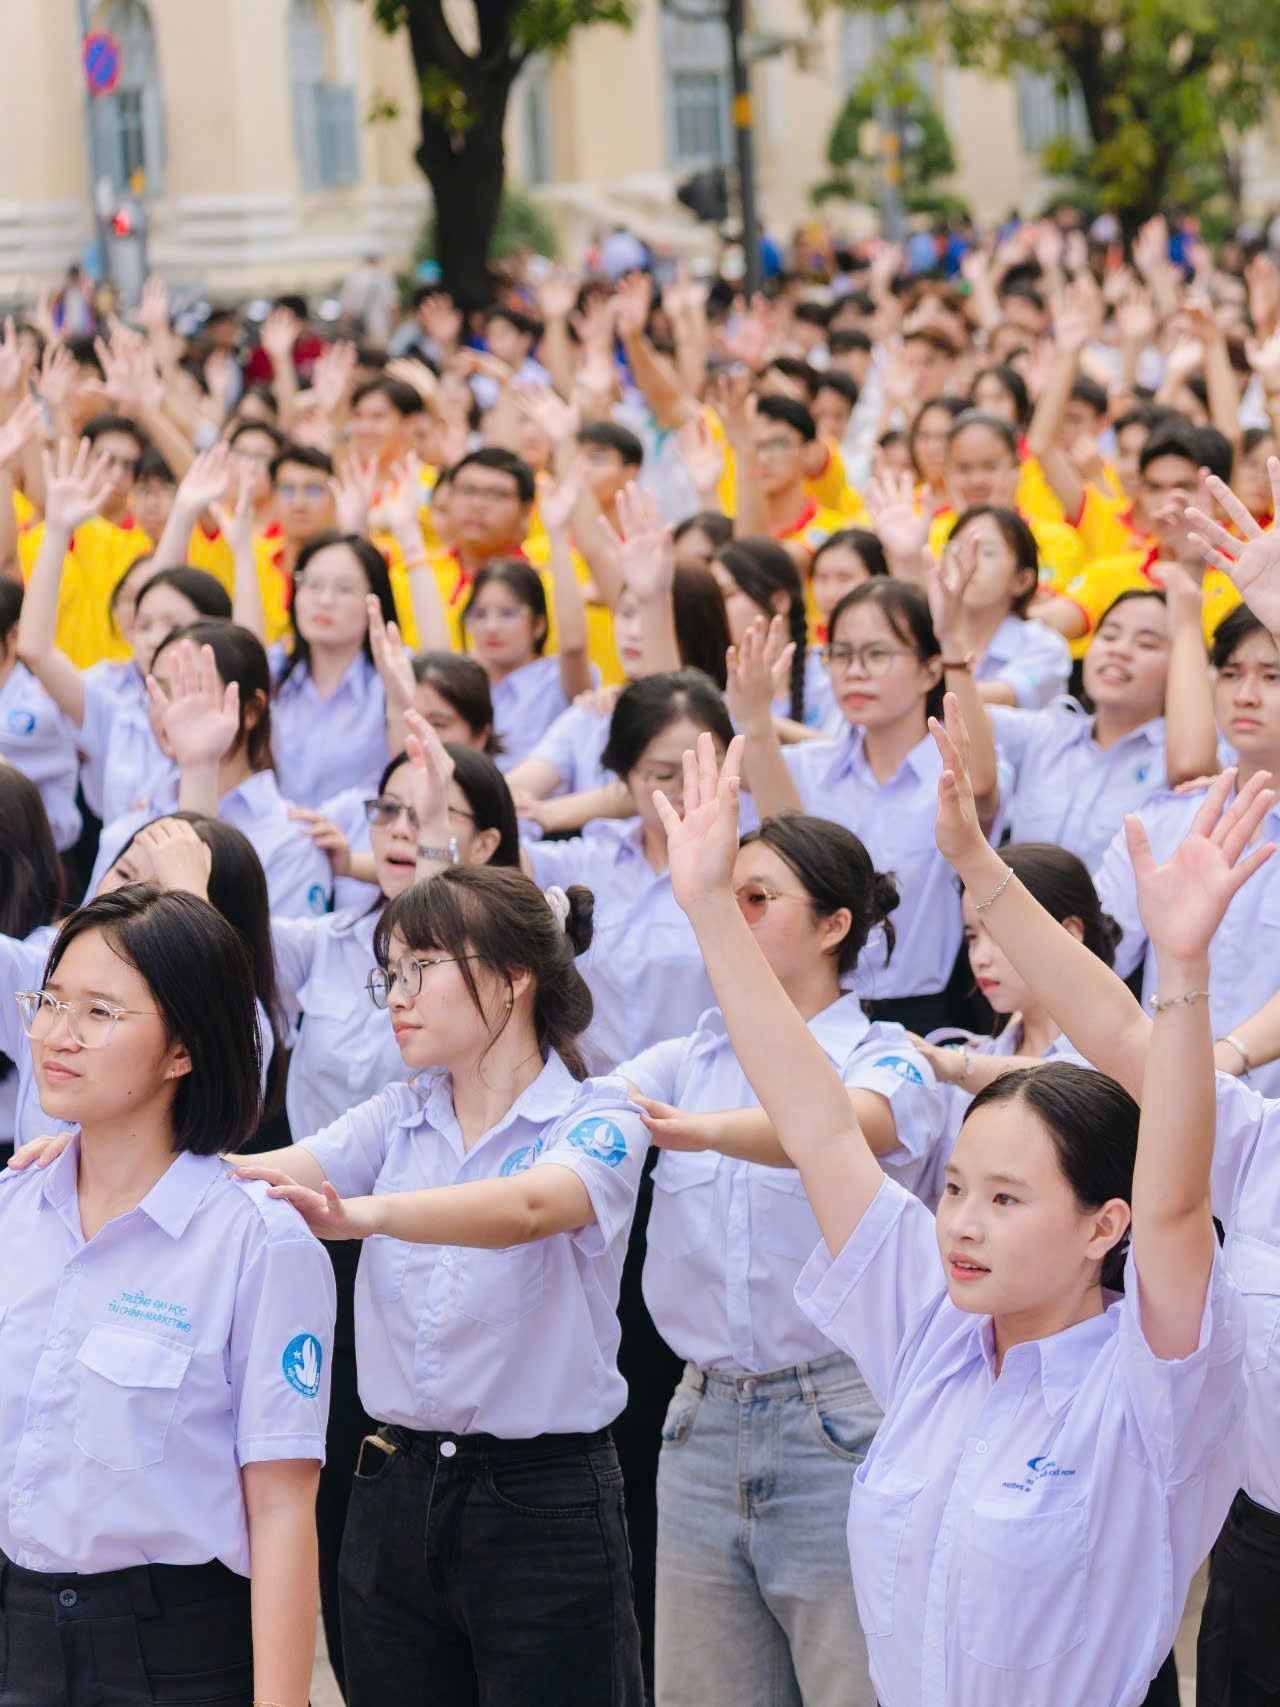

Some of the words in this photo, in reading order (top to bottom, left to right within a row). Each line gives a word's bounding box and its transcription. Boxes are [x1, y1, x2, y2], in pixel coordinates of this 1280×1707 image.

[108, 1300, 118, 1312] TÀI
[121, 1290, 151, 1306] TRƯỜNG
[168, 1303, 187, 1317] HỌC
